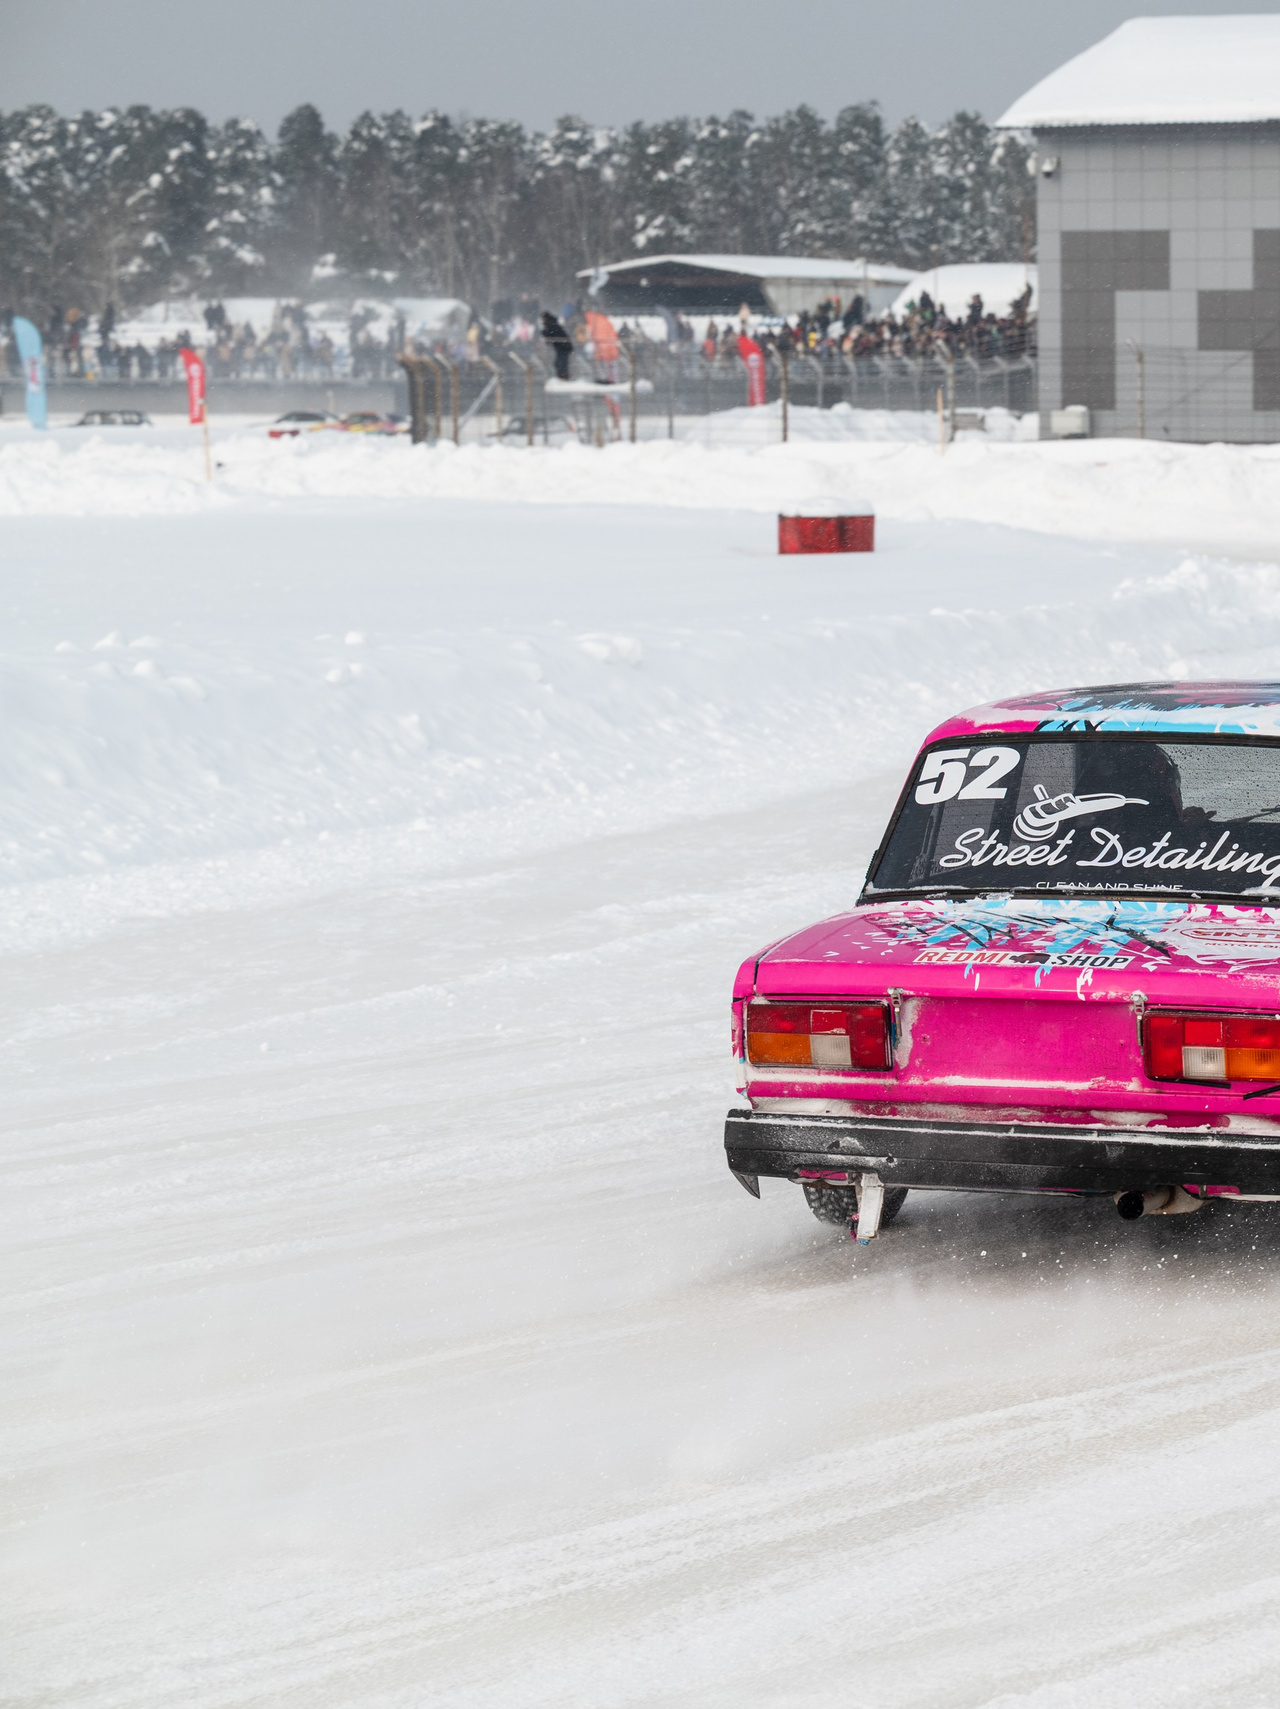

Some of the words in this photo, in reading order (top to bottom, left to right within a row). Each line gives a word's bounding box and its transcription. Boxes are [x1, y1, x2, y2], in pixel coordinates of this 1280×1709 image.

[915, 747, 1020, 805] 52
[939, 828, 1075, 867] Street
[1095, 882, 1129, 890] AND
[918, 951, 1010, 963] REDMI
